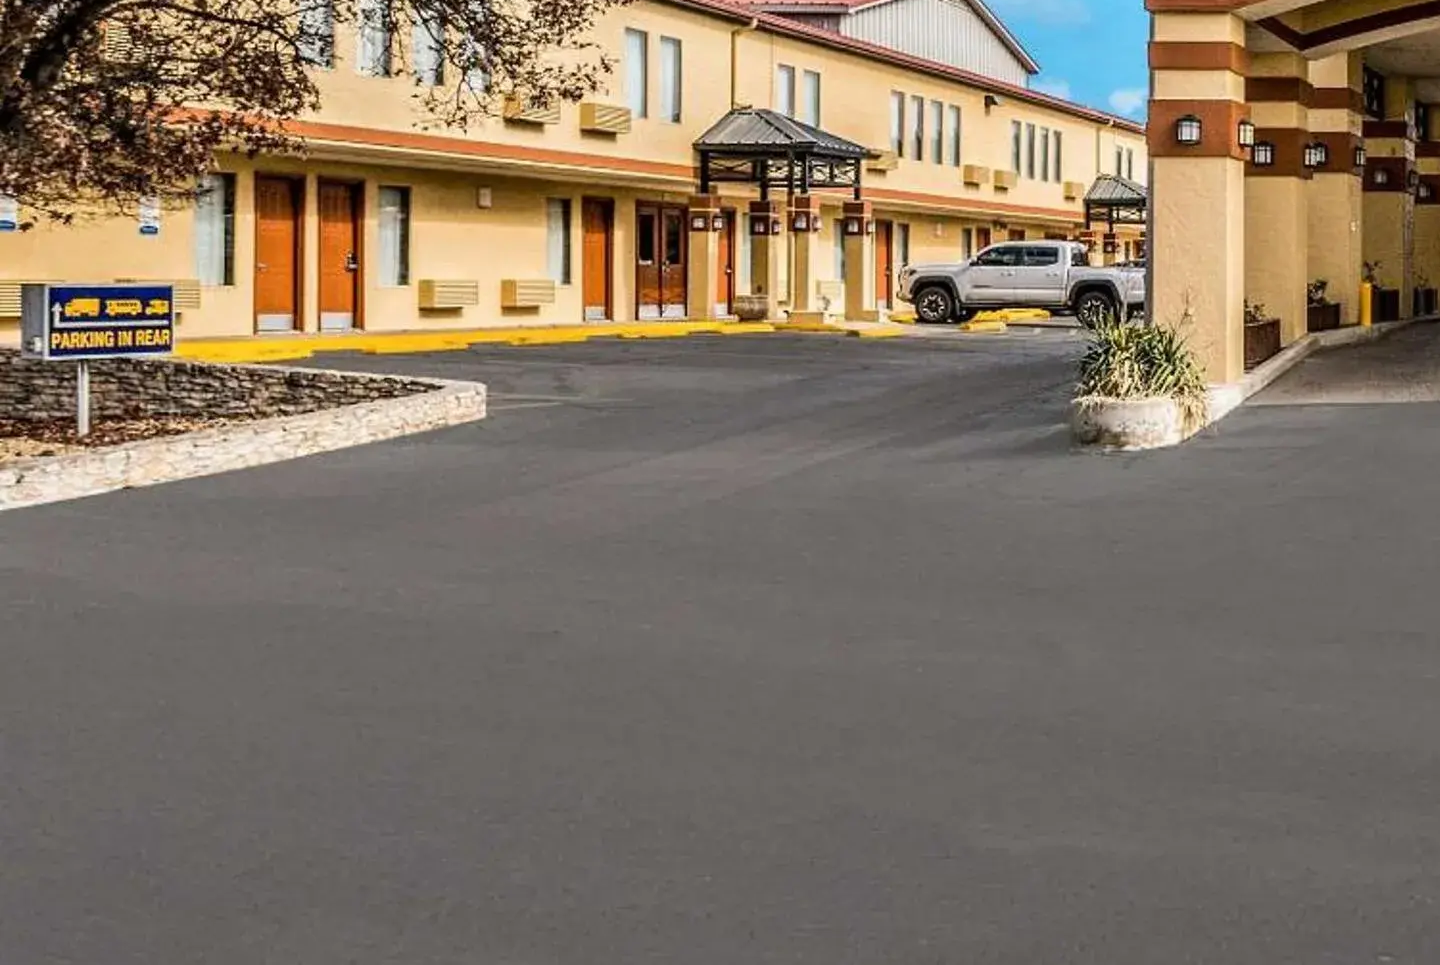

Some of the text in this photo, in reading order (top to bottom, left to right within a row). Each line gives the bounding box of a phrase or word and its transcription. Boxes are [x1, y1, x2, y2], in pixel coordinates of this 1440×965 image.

[51, 329, 171, 349] PARKING IN REAR
